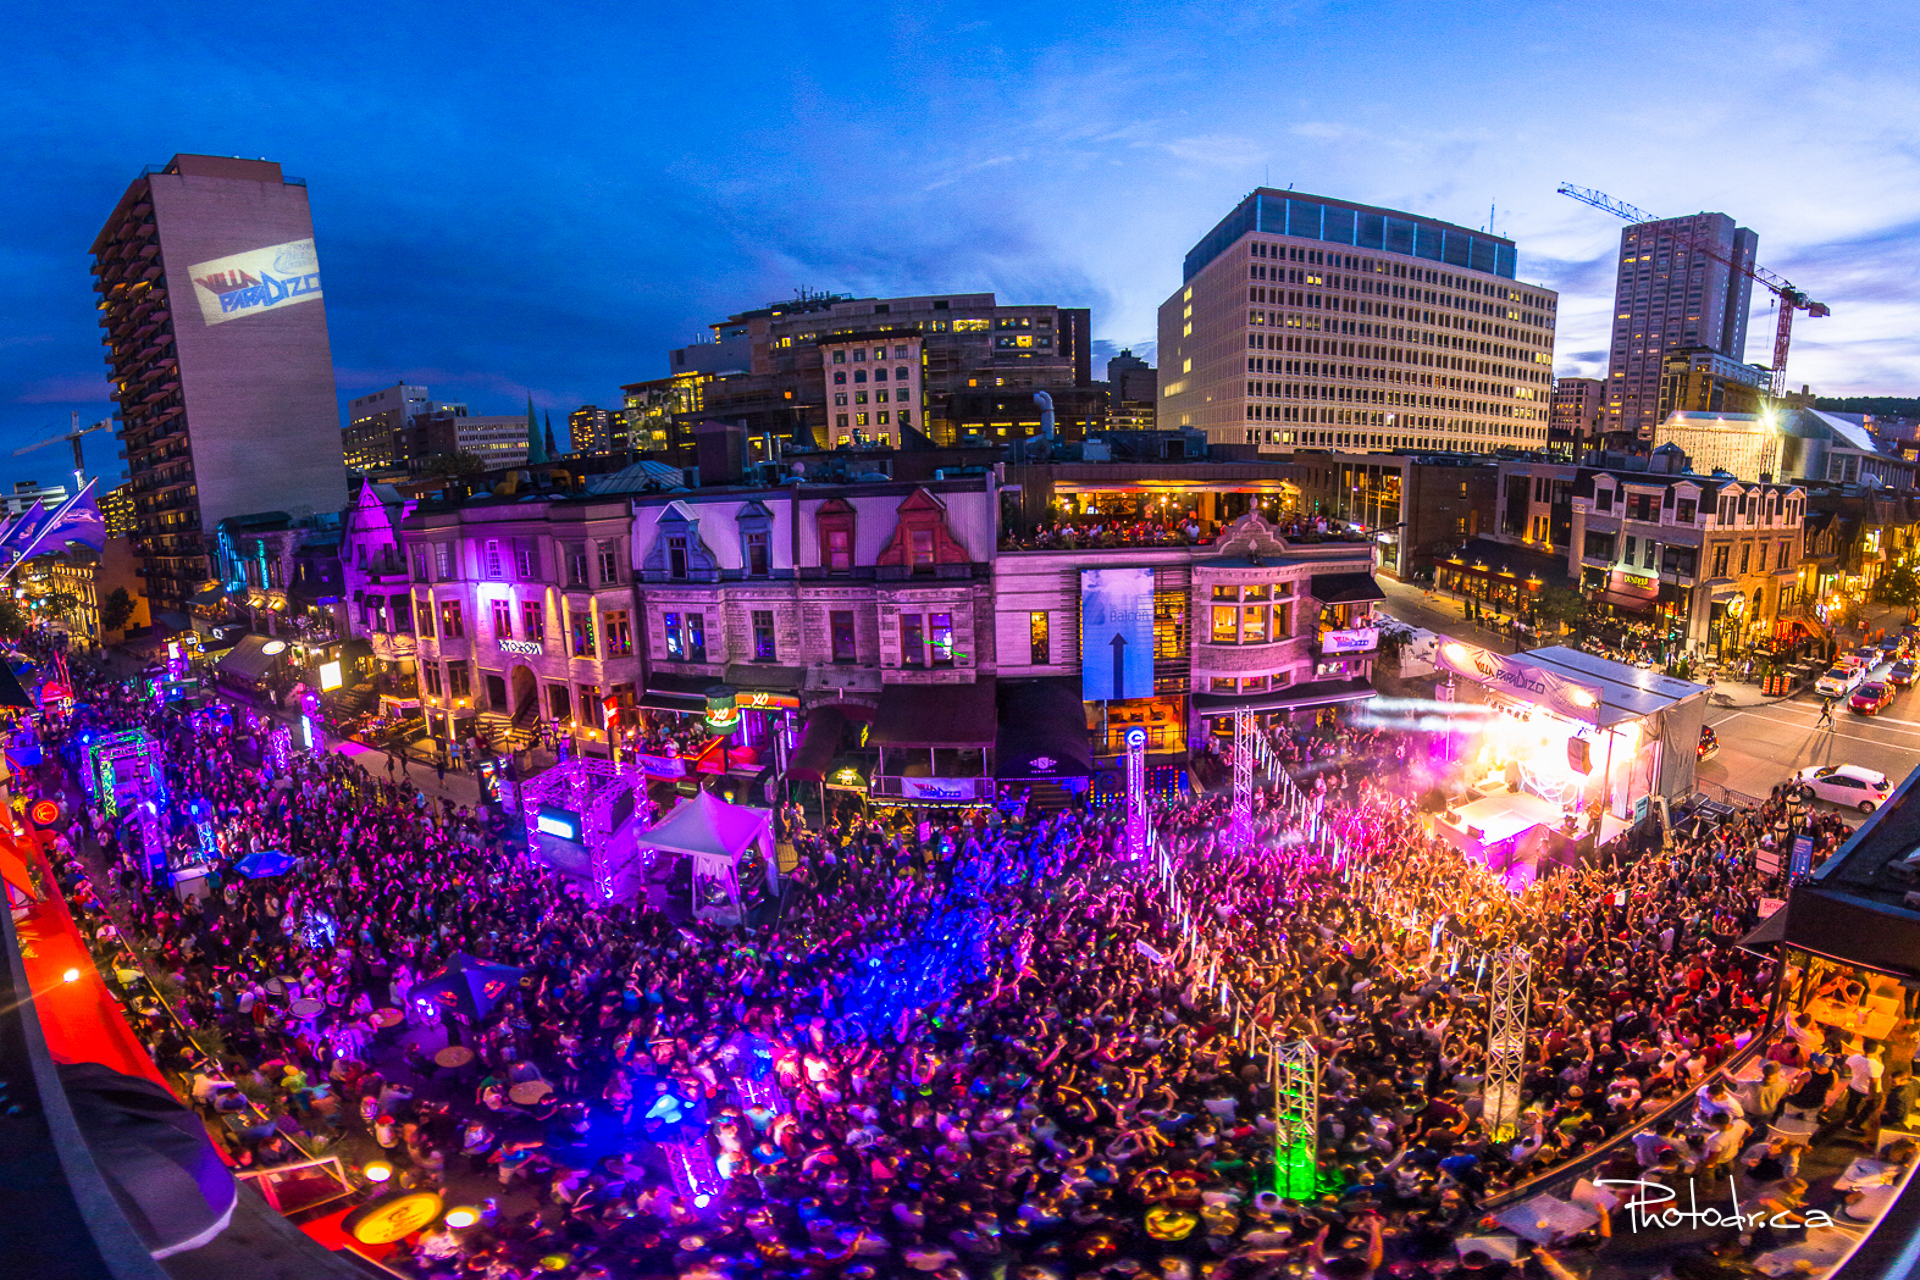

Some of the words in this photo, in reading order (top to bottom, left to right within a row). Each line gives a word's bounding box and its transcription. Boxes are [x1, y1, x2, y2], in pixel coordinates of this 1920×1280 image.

[1110, 610, 1150, 622] Balcon
[1474, 660, 1495, 678] VILLA
[1496, 669, 1546, 695] PARADIZO
[752, 692, 769, 708] XO
[713, 707, 730, 721] XO
